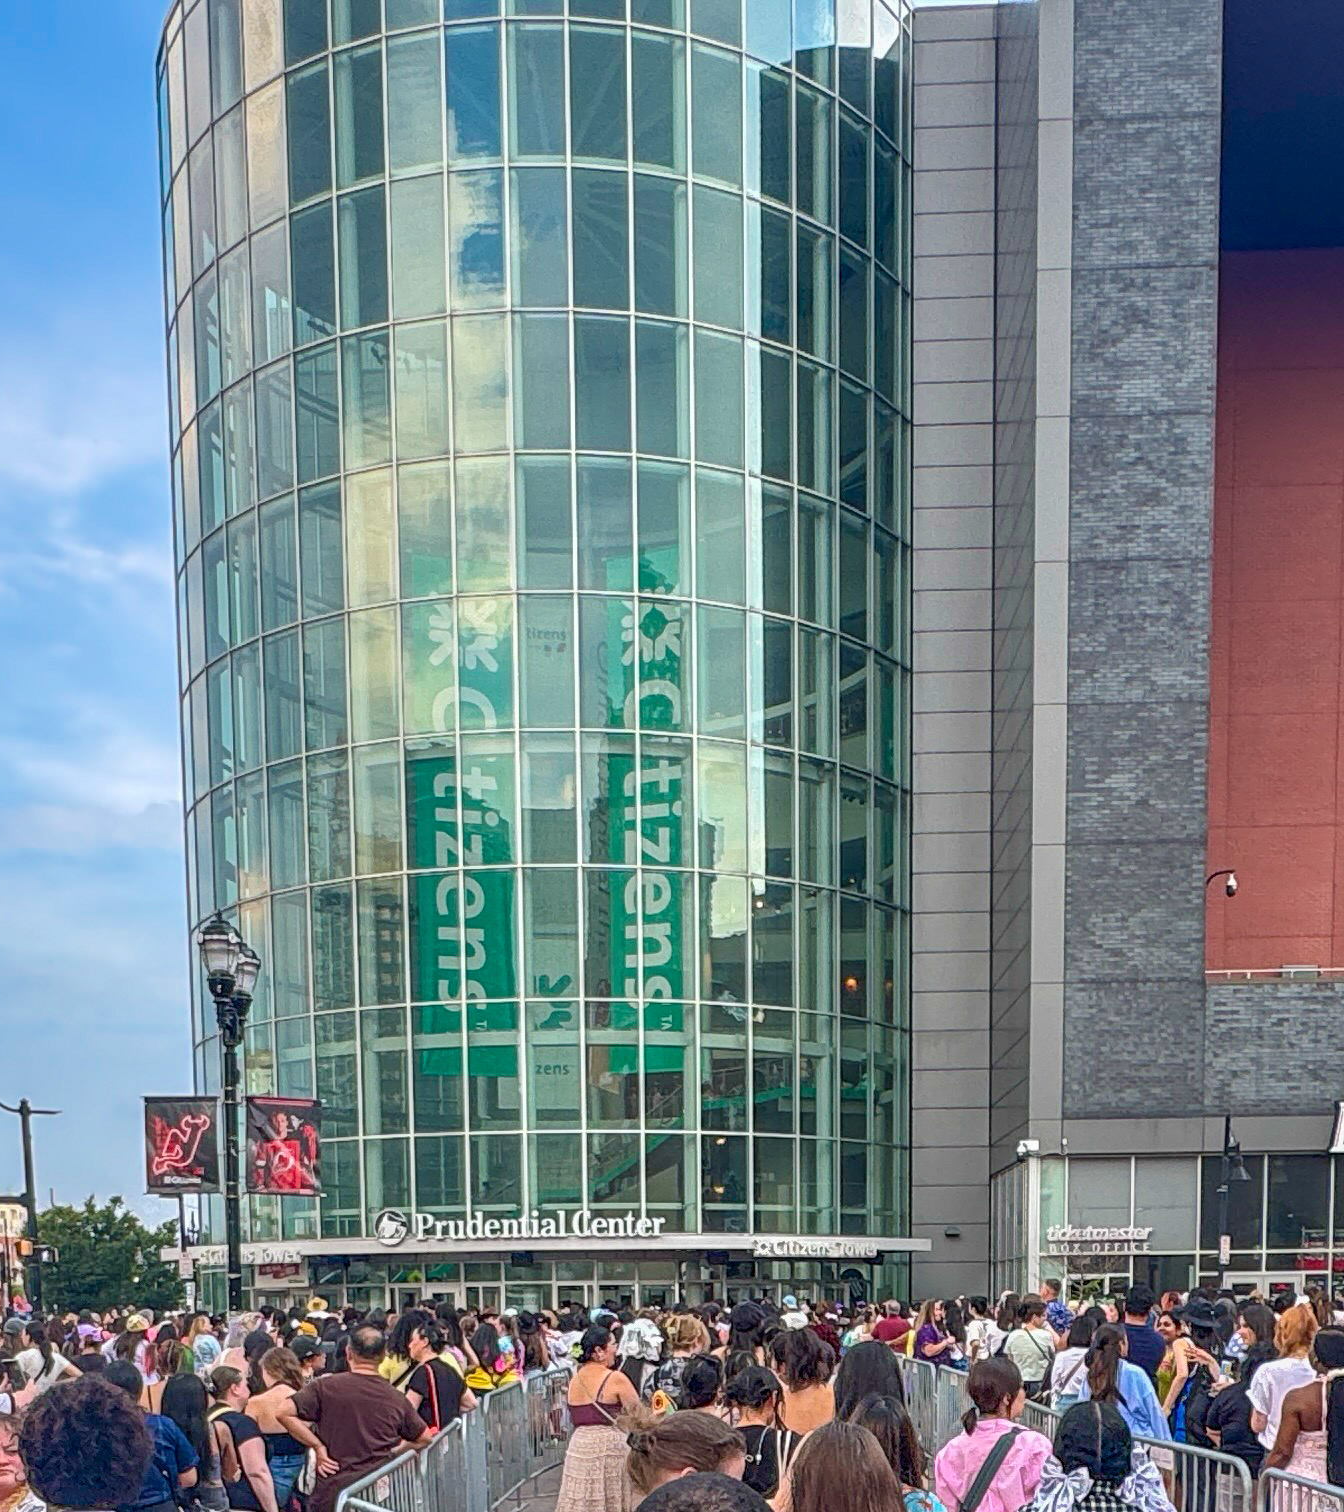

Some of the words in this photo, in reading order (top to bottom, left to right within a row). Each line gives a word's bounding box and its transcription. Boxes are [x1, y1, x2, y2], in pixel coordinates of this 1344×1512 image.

[432, 684, 499, 1013] Ctizens
[622, 679, 683, 1010] Ctizens
[535, 1064, 570, 1075] zens
[415, 1210, 566, 1240] Prudential
[572, 1209, 666, 1238] Center
[1046, 1224, 1154, 1242] ticketmaster
[773, 1240, 831, 1256] Citizens
[1048, 1242, 1081, 1254] BOX
[1092, 1242, 1152, 1253] OFFICE
